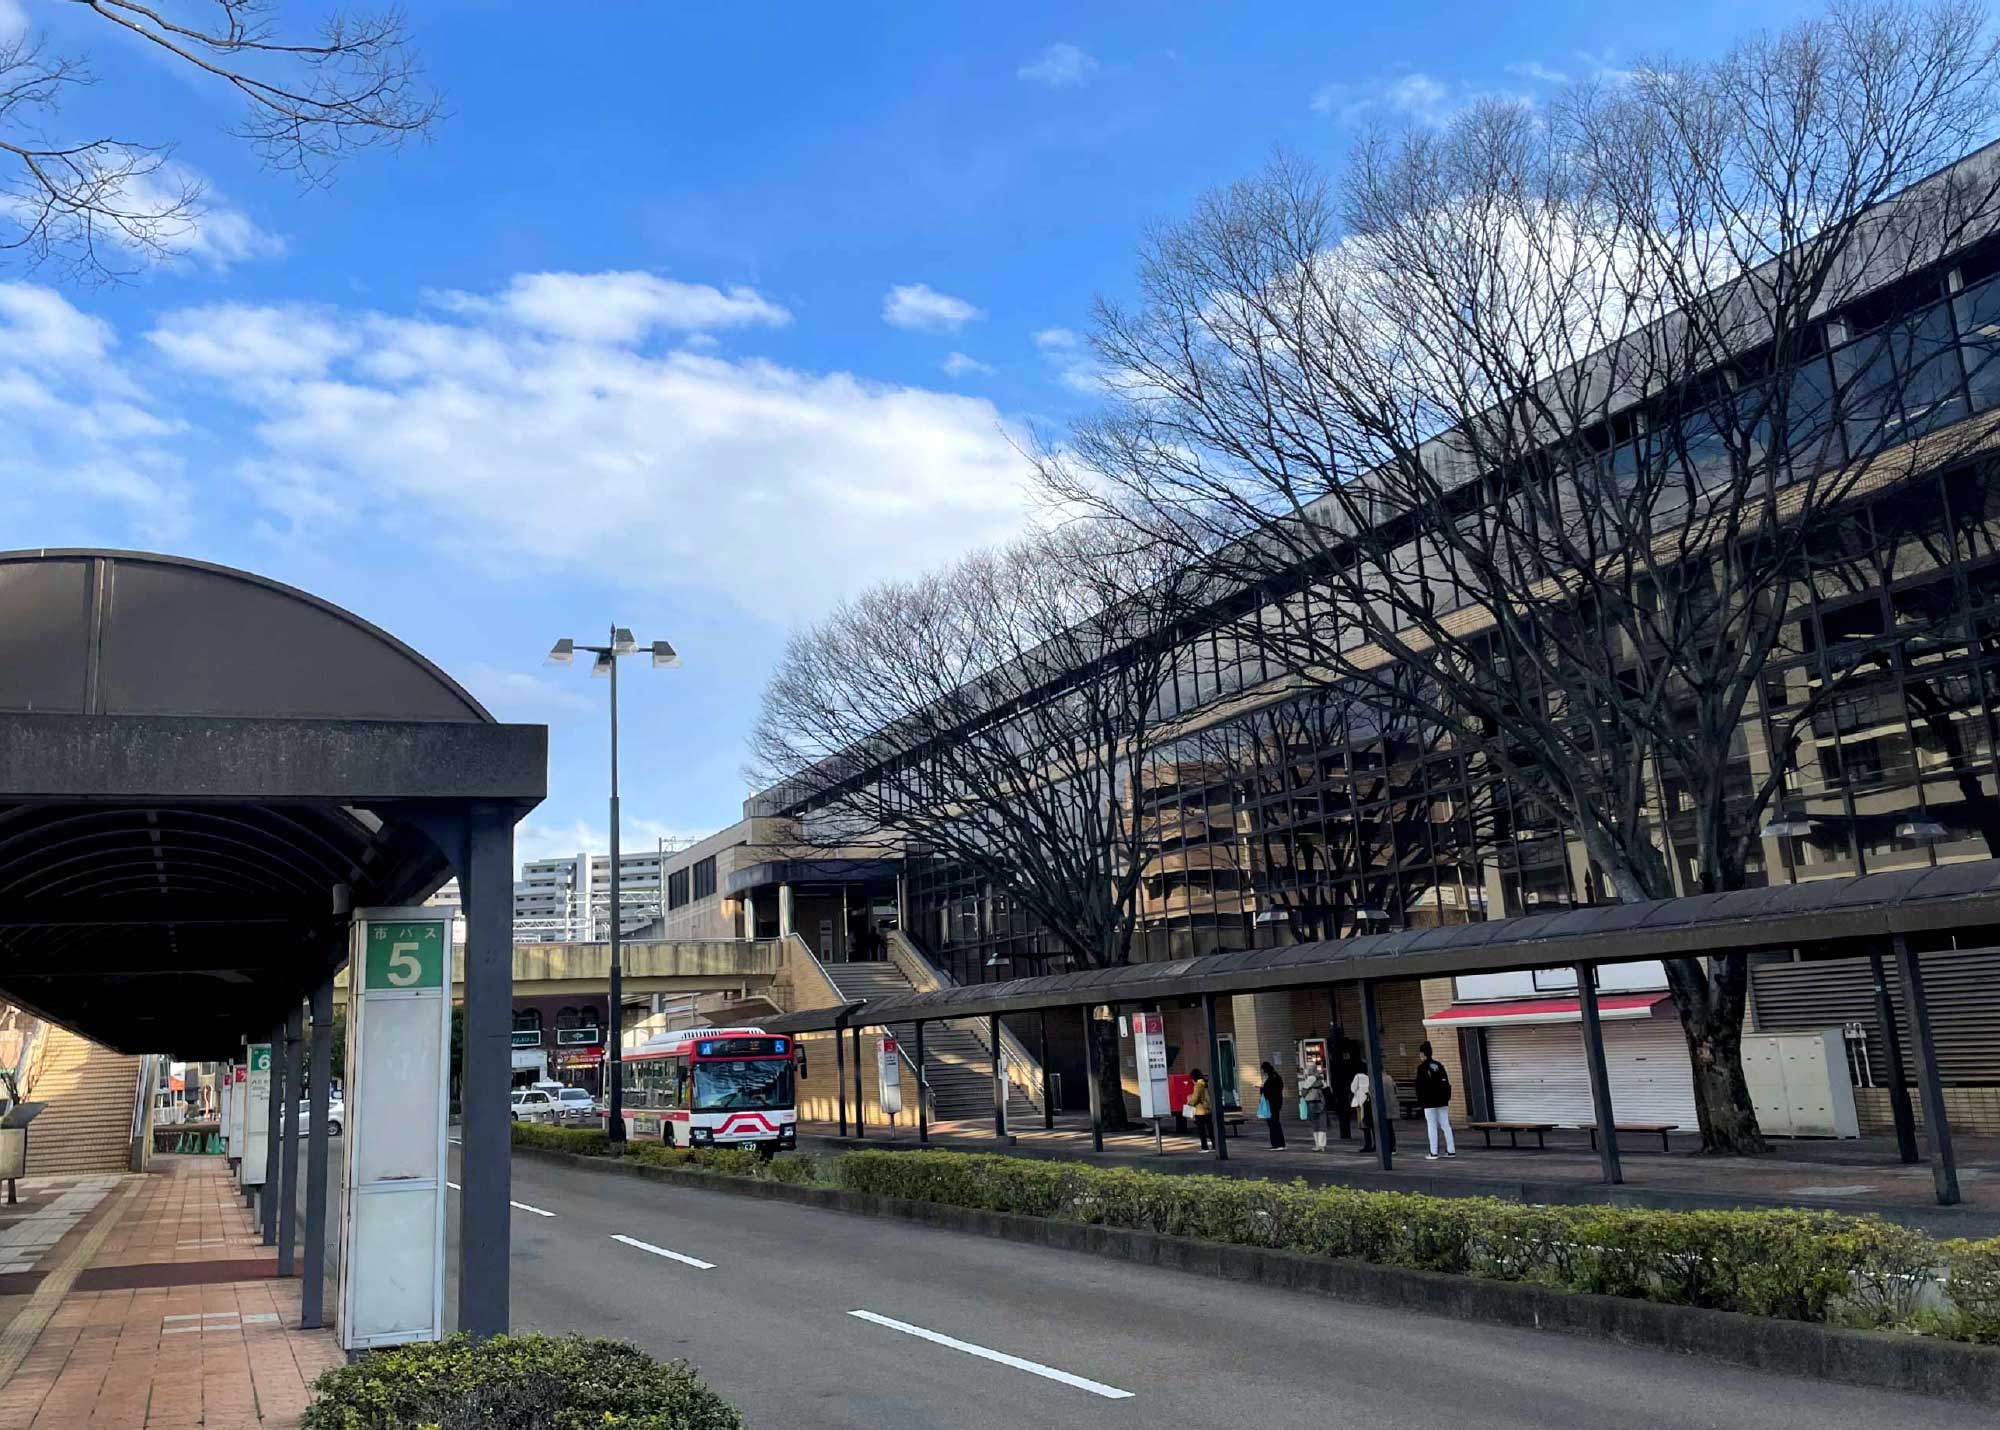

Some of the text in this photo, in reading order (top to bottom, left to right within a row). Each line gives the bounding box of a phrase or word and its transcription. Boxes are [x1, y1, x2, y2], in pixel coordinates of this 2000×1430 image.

[373, 926, 437, 941] 市バス
[387, 942, 422, 987] 5
[258, 1054, 271, 1070] 6
